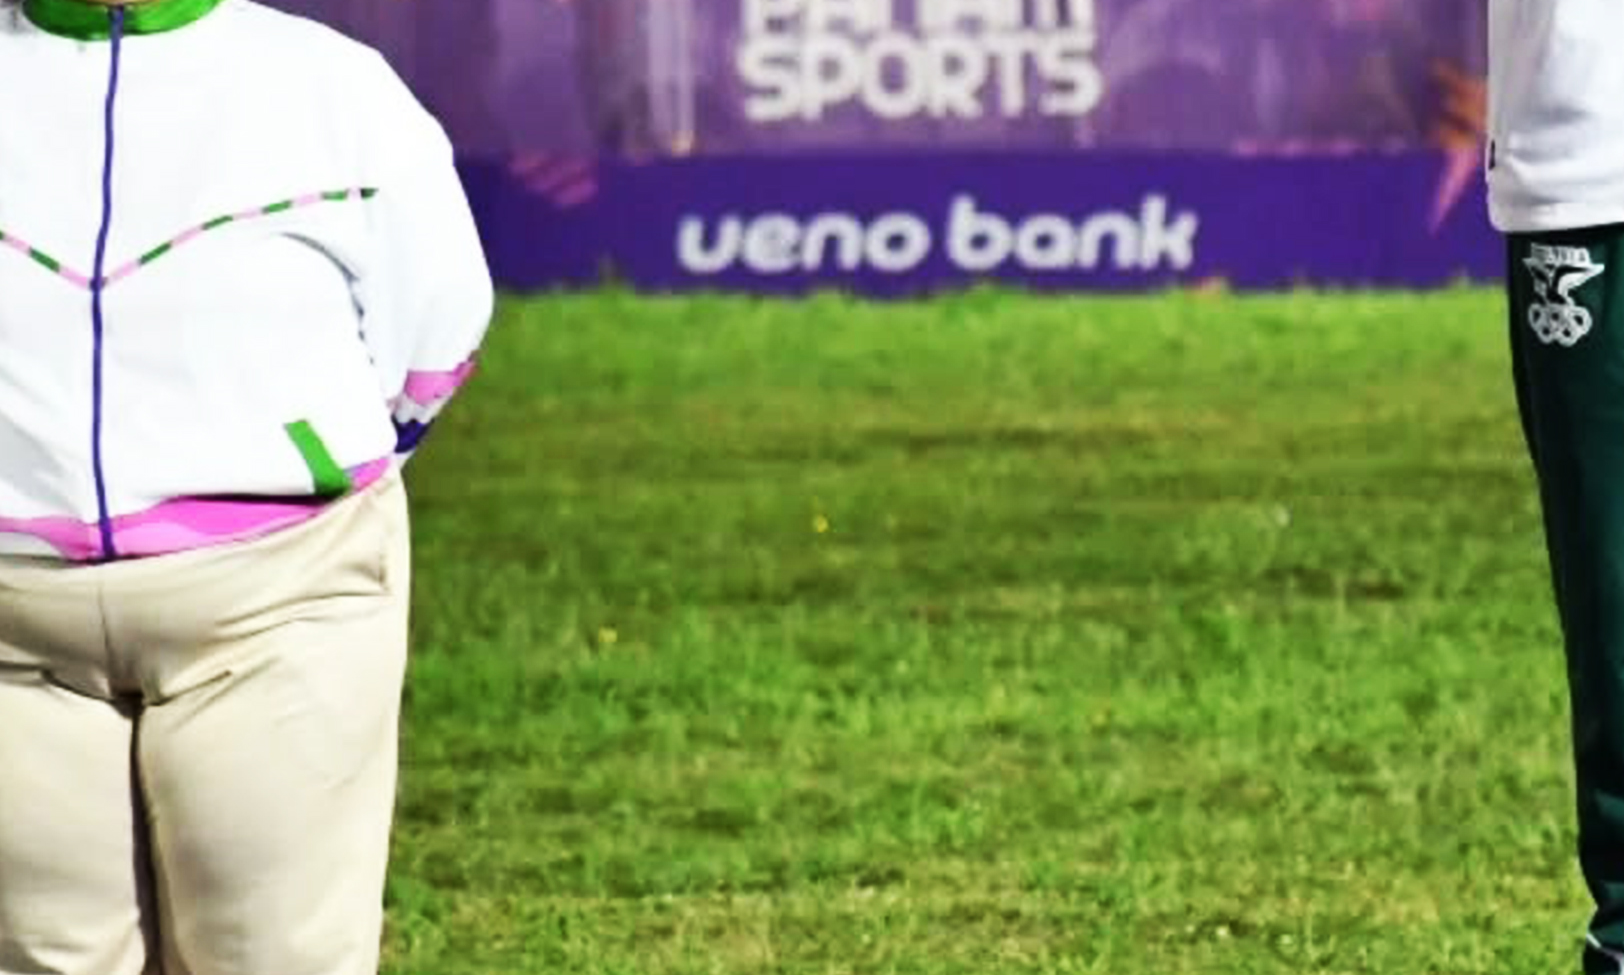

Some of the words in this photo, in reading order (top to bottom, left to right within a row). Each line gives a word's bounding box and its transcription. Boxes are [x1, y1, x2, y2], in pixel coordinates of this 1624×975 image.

[735, 31, 1105, 122] SPORTS
[678, 213, 931, 272] ueno
[946, 195, 1197, 271] bank
